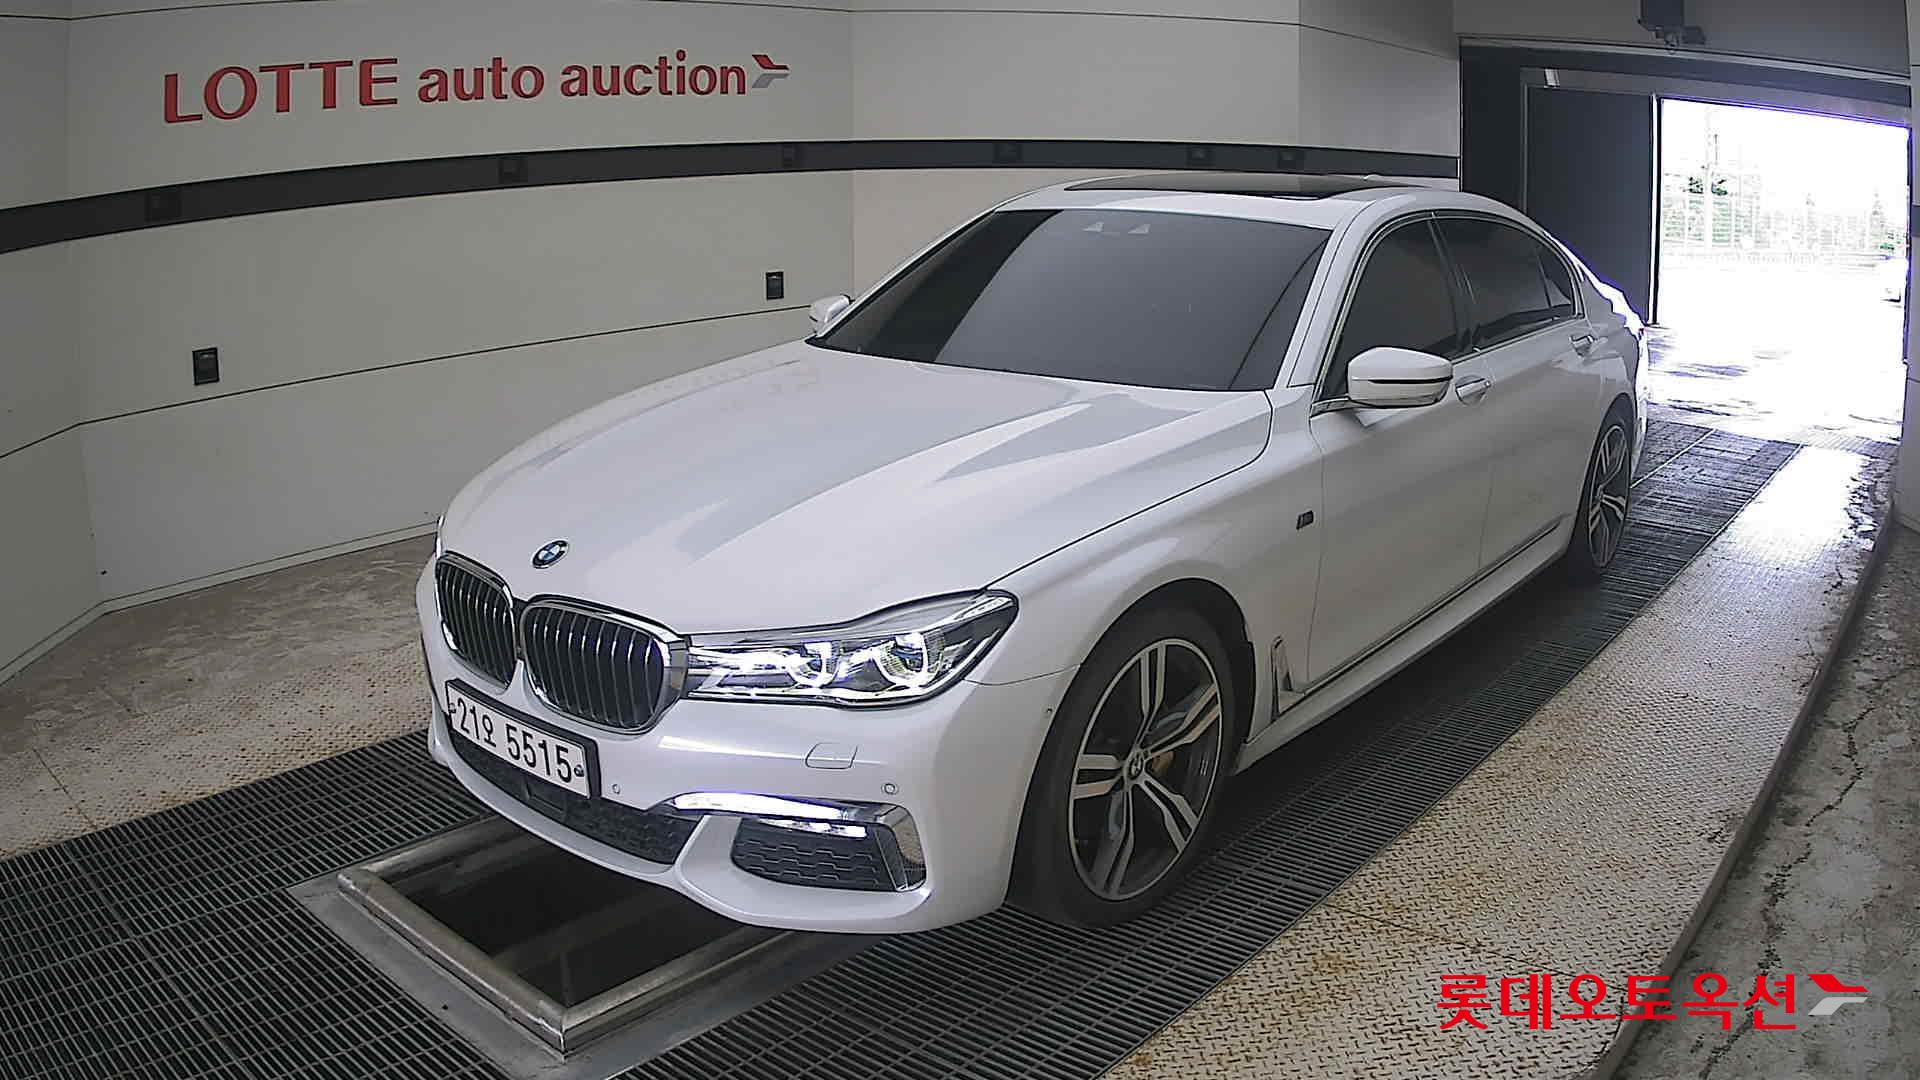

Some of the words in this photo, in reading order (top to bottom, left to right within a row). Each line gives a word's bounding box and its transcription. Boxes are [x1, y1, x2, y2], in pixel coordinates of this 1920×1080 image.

[163, 57, 399, 124] LOTTE
[417, 56, 545, 103] auto
[560, 49, 748, 97] auction
[505, 723, 572, 784] 5515
